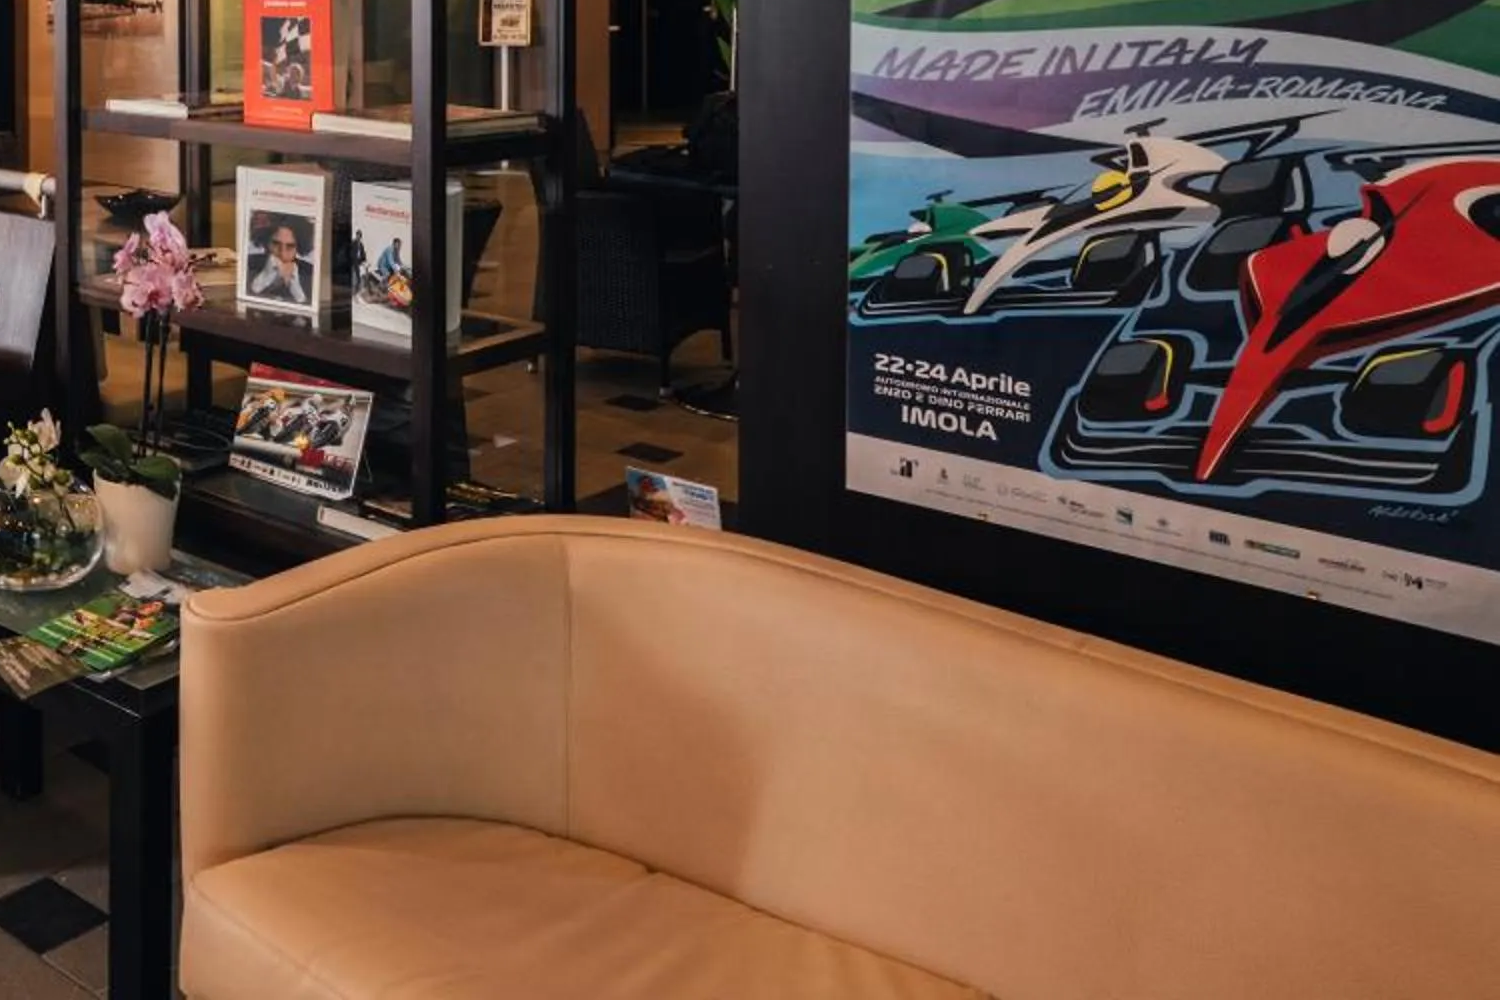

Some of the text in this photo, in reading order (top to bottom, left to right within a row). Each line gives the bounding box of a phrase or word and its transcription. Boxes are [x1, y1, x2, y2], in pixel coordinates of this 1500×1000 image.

[872, 37, 1269, 81] MADE IN ITALY
[1072, 74, 1449, 121] EMILIA-ROMAGNA
[951, 366, 1031, 397] Aprile
[901, 404, 998, 442] IMOLA
[928, 395, 964, 410] DINO
[967, 401, 1031, 423] FERRARI
